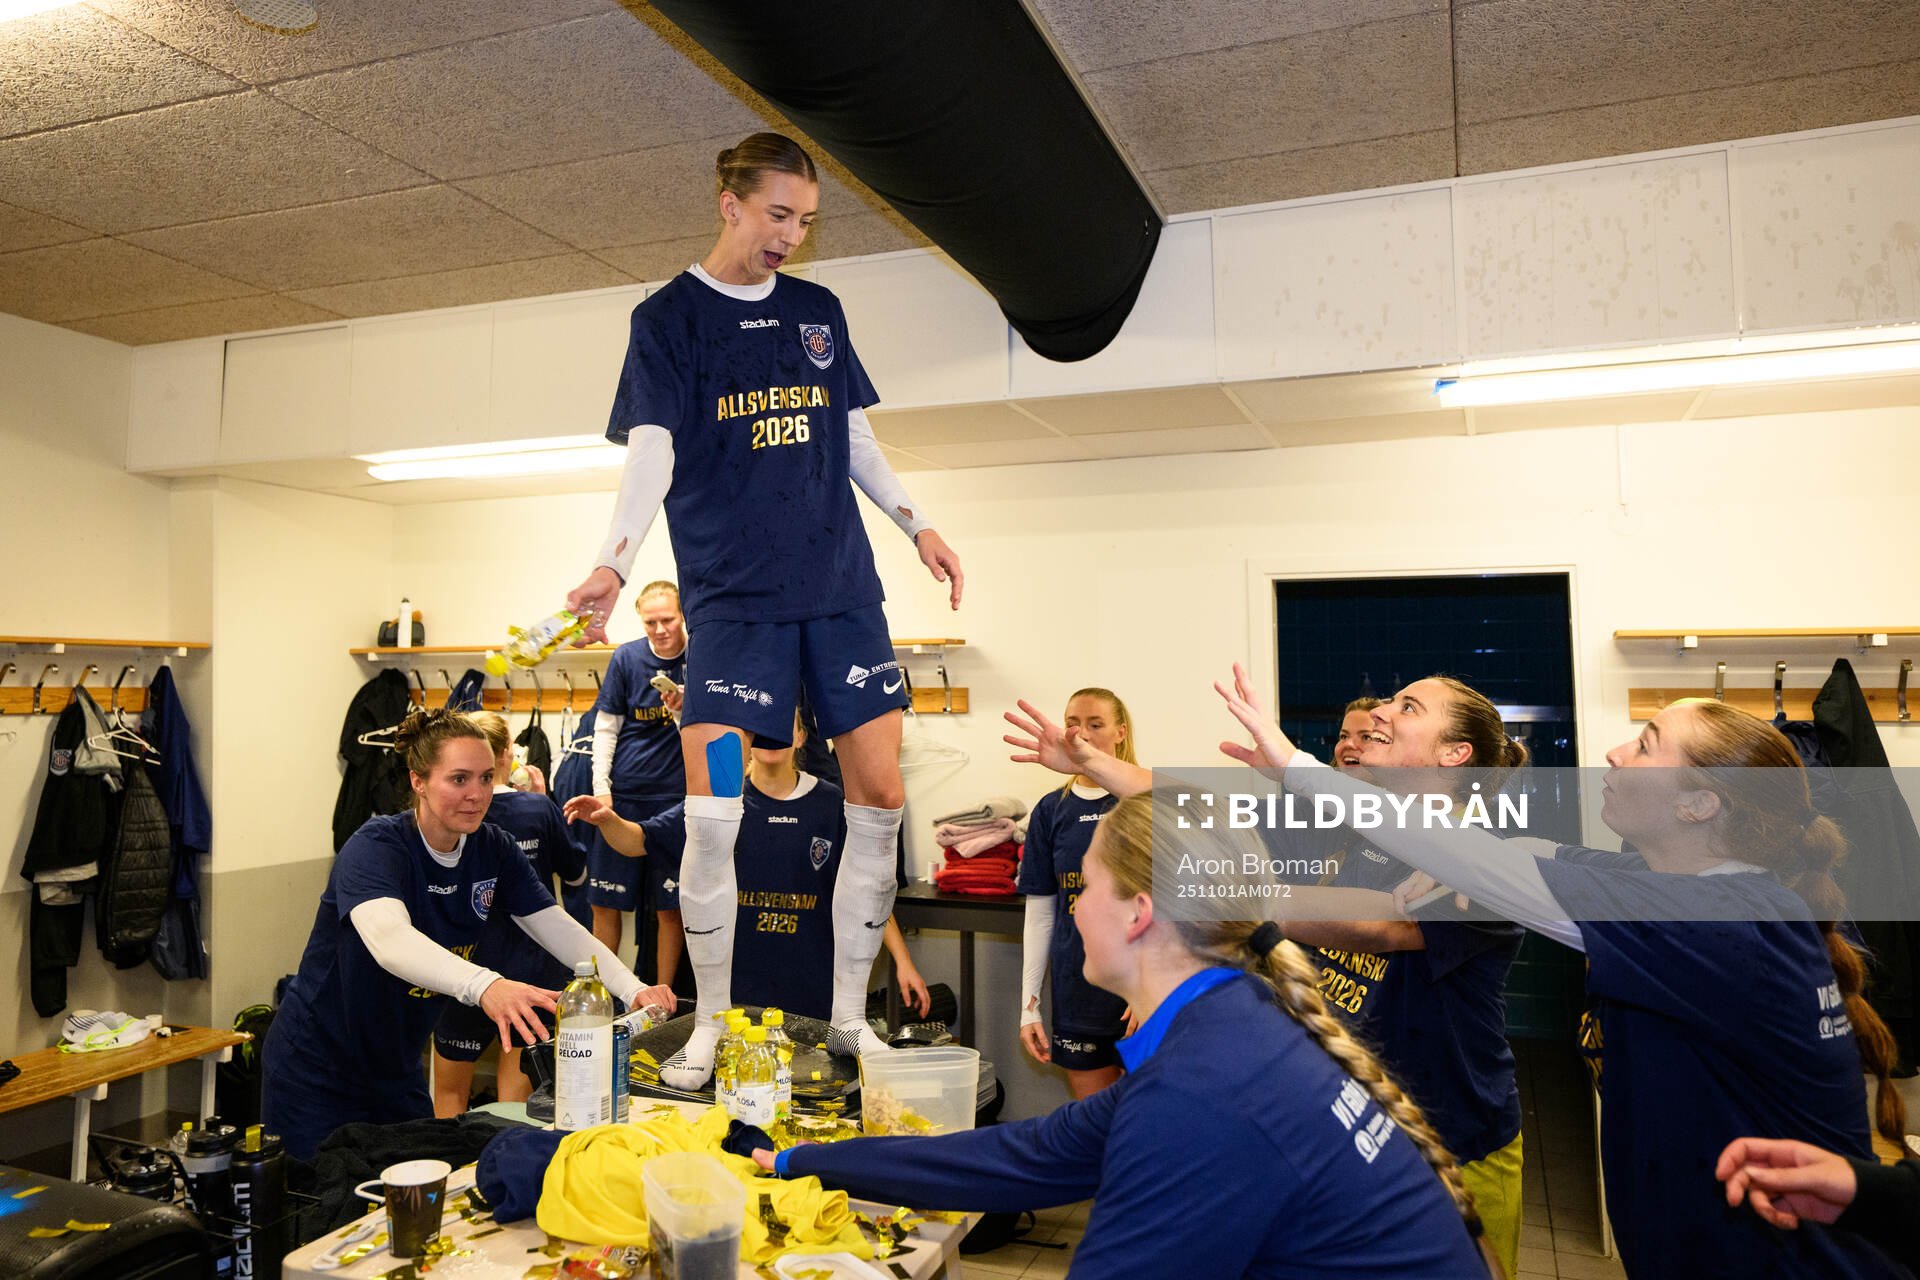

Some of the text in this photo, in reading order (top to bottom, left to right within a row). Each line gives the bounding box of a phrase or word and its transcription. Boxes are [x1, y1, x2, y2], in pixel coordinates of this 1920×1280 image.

[740, 319, 780, 329] stadium
[717, 385, 830, 422] ALLSVENSKAN
[752, 414, 810, 450] 2026
[849, 671, 867, 682] TUNA
[705, 679, 758, 703] Tuna Trafik
[768, 816, 798, 824] stadium
[737, 890, 818, 910] ALLSVENSKAN
[756, 912, 799, 935] 2026
[1315, 966, 1368, 1014] 2026
